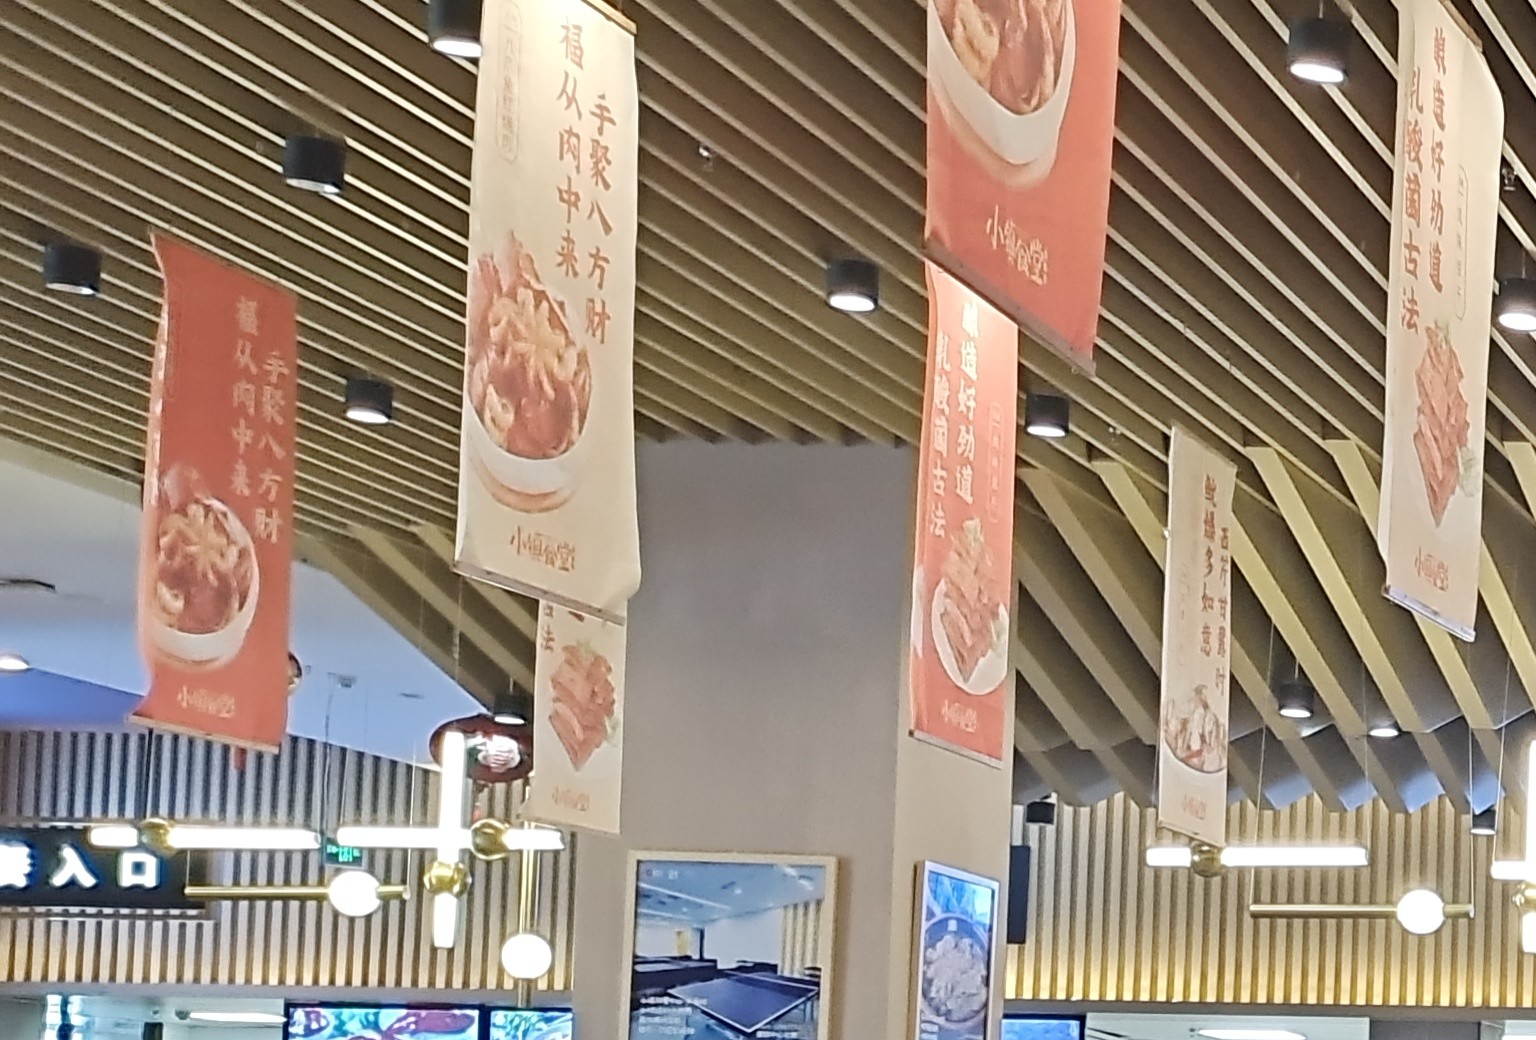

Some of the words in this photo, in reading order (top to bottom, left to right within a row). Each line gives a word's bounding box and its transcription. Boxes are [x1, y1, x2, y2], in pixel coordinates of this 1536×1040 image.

[556, 17, 584, 279] 福从肉中来
[585, 93, 616, 345] 手聚八方财
[1401, 66, 1423, 336] 乳酸菌古法
[230, 296, 259, 497] 福从肉中来
[254, 350, 290, 546] 手聚八方财
